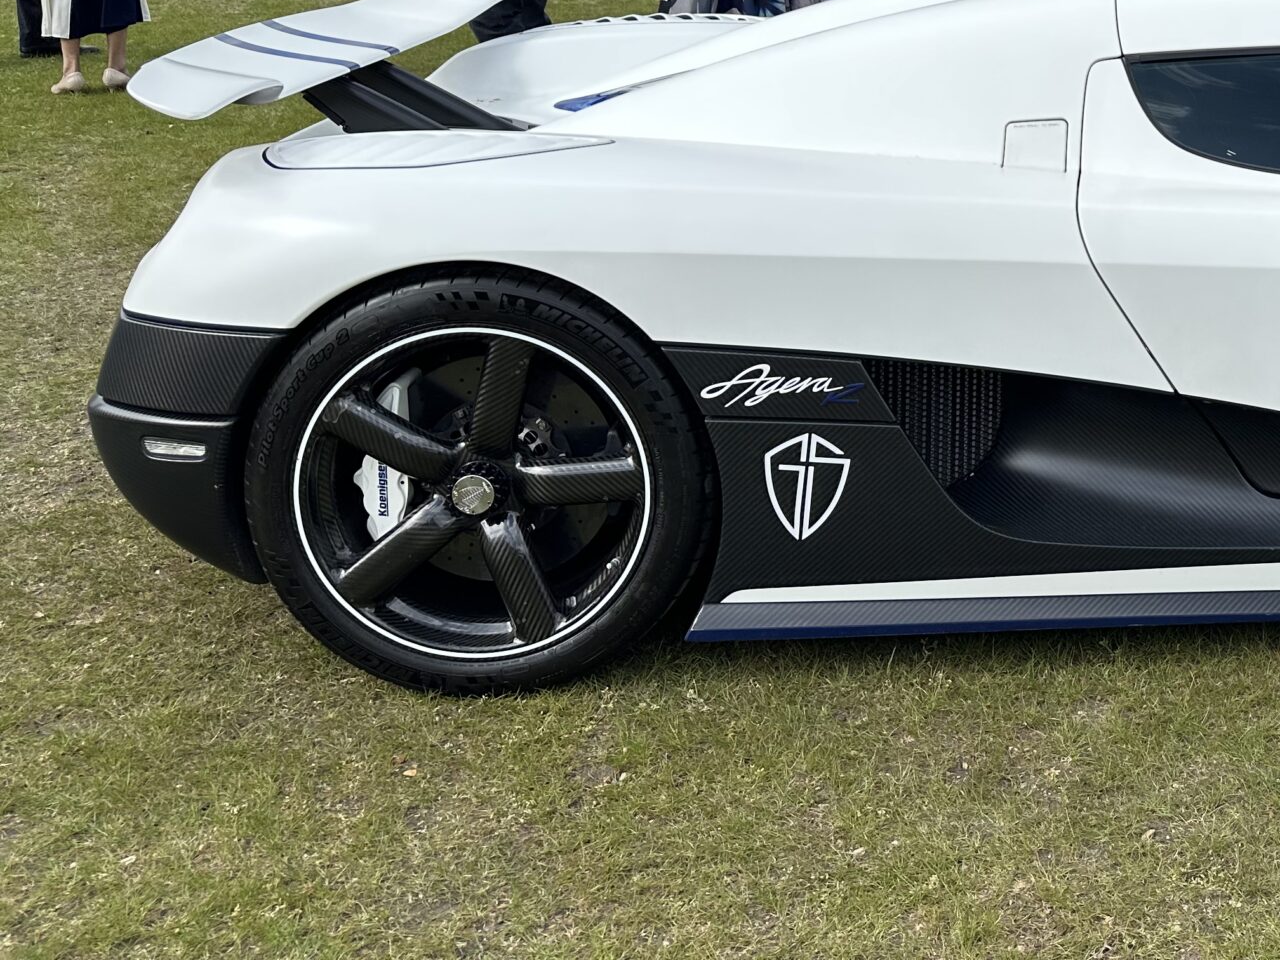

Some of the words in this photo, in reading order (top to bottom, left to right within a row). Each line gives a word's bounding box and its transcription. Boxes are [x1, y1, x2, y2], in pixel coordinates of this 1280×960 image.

[306, 342, 336, 371] Cup
[336, 327, 350, 347] 2
[532, 302, 649, 389] MICHELIN
[700, 363, 844, 407] Agera
